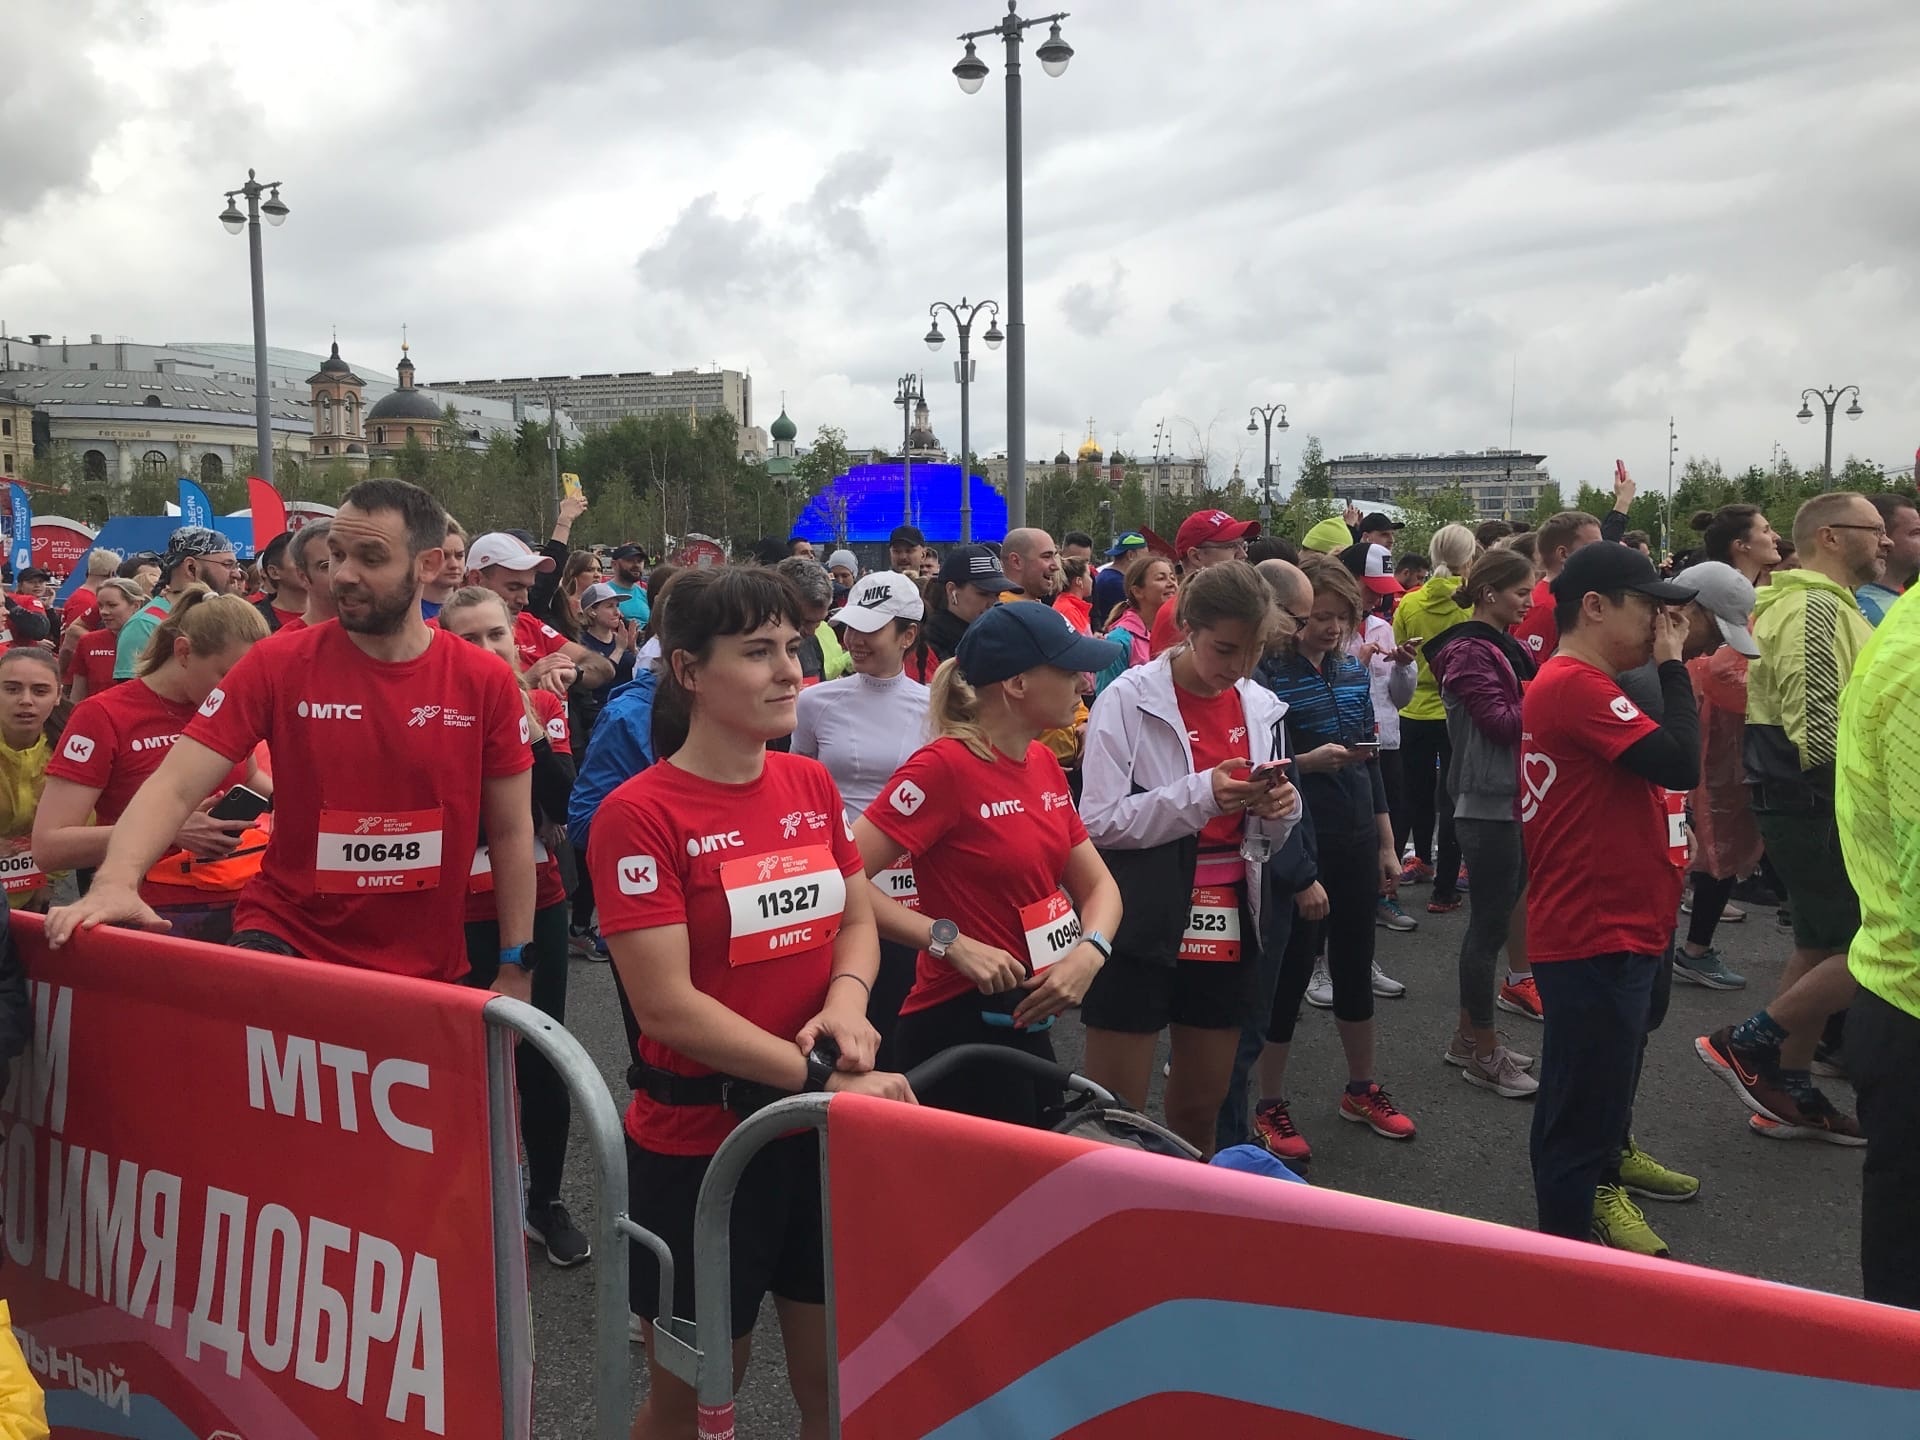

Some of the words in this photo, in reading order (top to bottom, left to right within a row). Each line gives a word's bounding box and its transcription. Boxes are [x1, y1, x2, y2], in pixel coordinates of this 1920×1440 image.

[863, 585, 892, 602] NIKE
[312, 703, 362, 720] МТС
[443, 713, 476, 722] БЕГУЩИЕ
[443, 720, 472, 728] СЕРДЦА
[70, 741, 88, 757] VK
[899, 788, 918, 809] VK
[992, 799, 1025, 817] МТС
[701, 829, 745, 855] МТС
[342, 841, 420, 862] 10648
[10, 878, 31, 889] МТС
[368, 874, 404, 887] МТС
[624, 866, 651, 884] VK
[890, 874, 917, 890] 116
[757, 884, 820, 919] 11327
[779, 927, 812, 948] МТС
[1188, 943, 1217, 954] МТС
[246, 1025, 434, 1154] МТС
[0, 1122, 36, 1267] О
[45, 1137, 182, 1329] ИМЯ
[186, 1185, 445, 1436] ДОБРА
